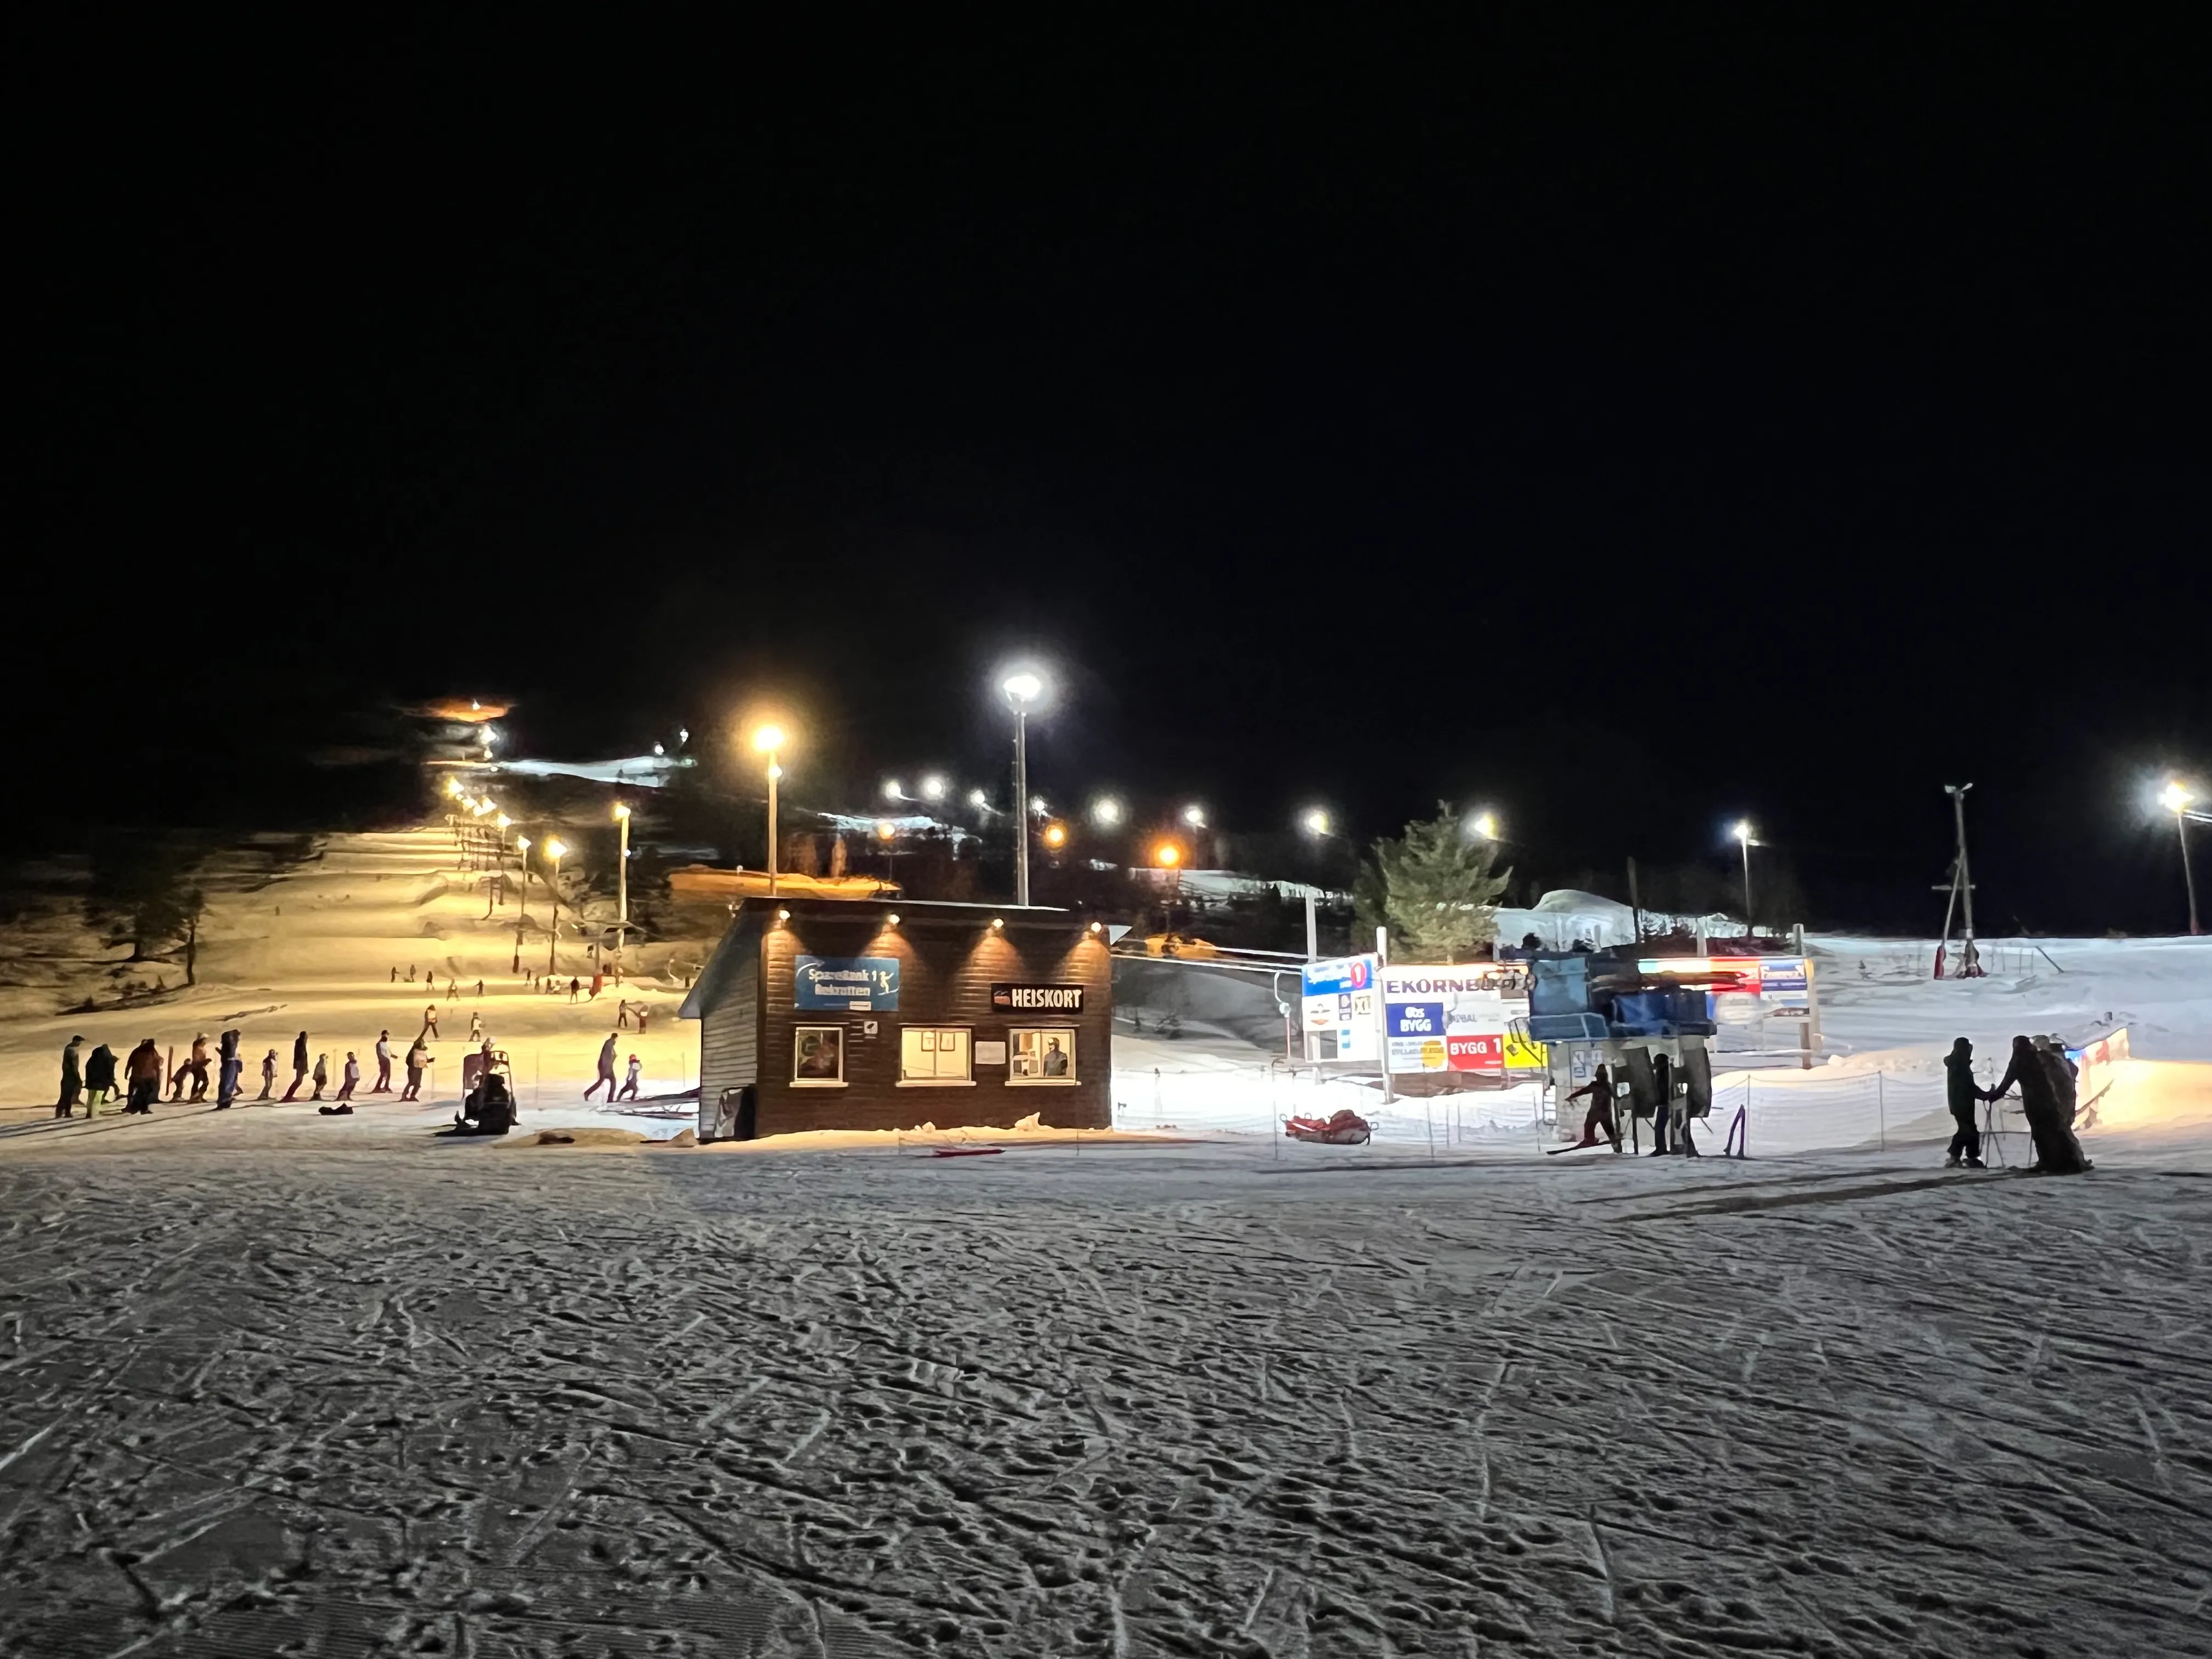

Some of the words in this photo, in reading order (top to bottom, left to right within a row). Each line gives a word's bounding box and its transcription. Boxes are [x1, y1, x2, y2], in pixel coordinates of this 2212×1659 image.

[1012, 989, 1082, 1008] HEISKORT
[1400, 1018, 1431, 1032] BYGG
[1450, 1041, 1487, 1056] BYGG
[1492, 1037, 1501, 1053] 1
